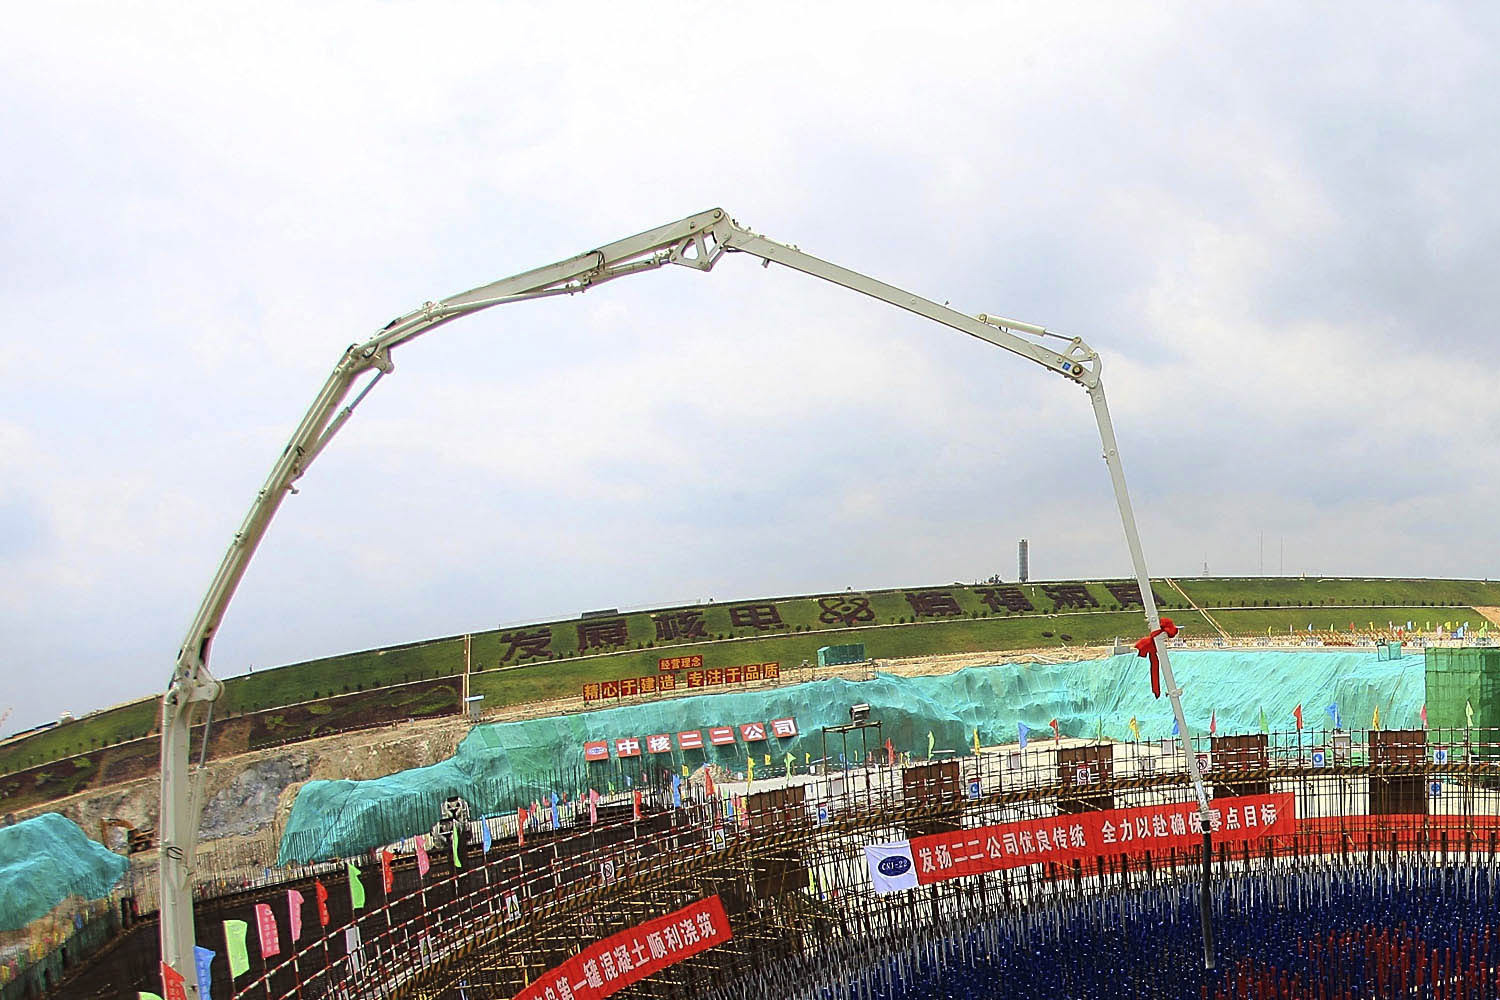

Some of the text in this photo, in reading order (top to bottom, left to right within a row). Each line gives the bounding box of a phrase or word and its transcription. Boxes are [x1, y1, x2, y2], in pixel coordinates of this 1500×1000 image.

[660, 656, 702, 671] 经营理念
[584, 664, 779, 700] 精心于建造 专注于品质
[618, 719, 796, 755] 中核二二公司
[918, 803, 1278, 874] 发扬二二公司优良传统 全力以赴确保零点目标
